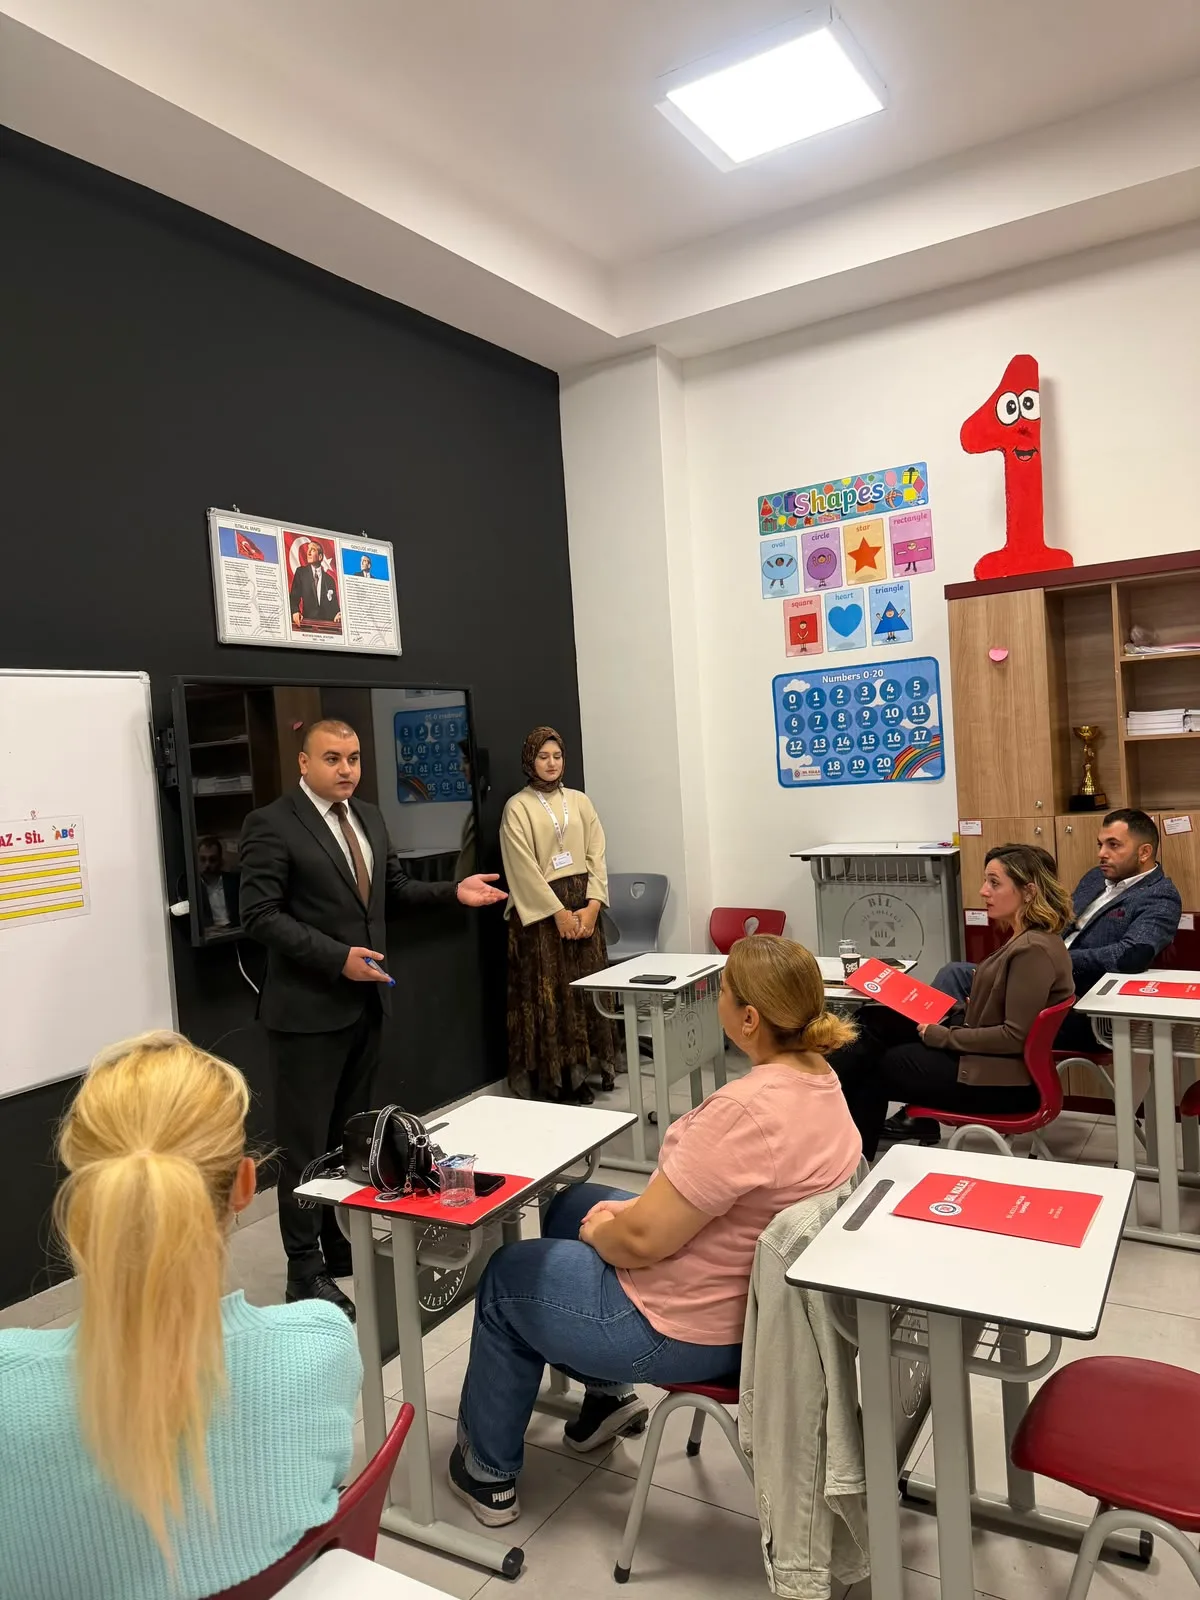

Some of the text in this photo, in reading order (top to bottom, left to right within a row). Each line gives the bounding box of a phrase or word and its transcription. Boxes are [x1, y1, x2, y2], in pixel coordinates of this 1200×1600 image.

[795, 483, 884, 517] Shapes
[893, 513, 927, 524] rectangle
[856, 524, 870, 532] star
[811, 532, 829, 541] circle
[771, 540, 785, 548] oval
[875, 584, 904, 594] triangle
[835, 592, 853, 600] heart
[791, 600, 813, 608] square
[822, 669, 884, 683] Numbers 0-20
[886, 683, 894, 693] 4
[913, 680, 920, 690] 5
[813, 691, 820, 701] 1
[836, 689, 844, 698] 2
[861, 686, 869, 696] 3
[789, 694, 796, 703] 0
[862, 711, 870, 720] 9
[885, 708, 899, 718] 10
[911, 705, 925, 716] 11
[791, 717, 798, 727] 6
[814, 715, 821, 724] 7
[838, 713, 845, 722] 8
[861, 735, 875, 745] 15
[887, 732, 900, 742] 16
[913, 731, 927, 740] 17
[790, 741, 802, 750] 12
[813, 738, 826, 748] 13
[837, 736, 850, 747] 14
[827, 761, 840, 770] 18
[852, 760, 865, 769] 19
[877, 758, 891, 767] 20
[25, 830, 44, 844] SİL
